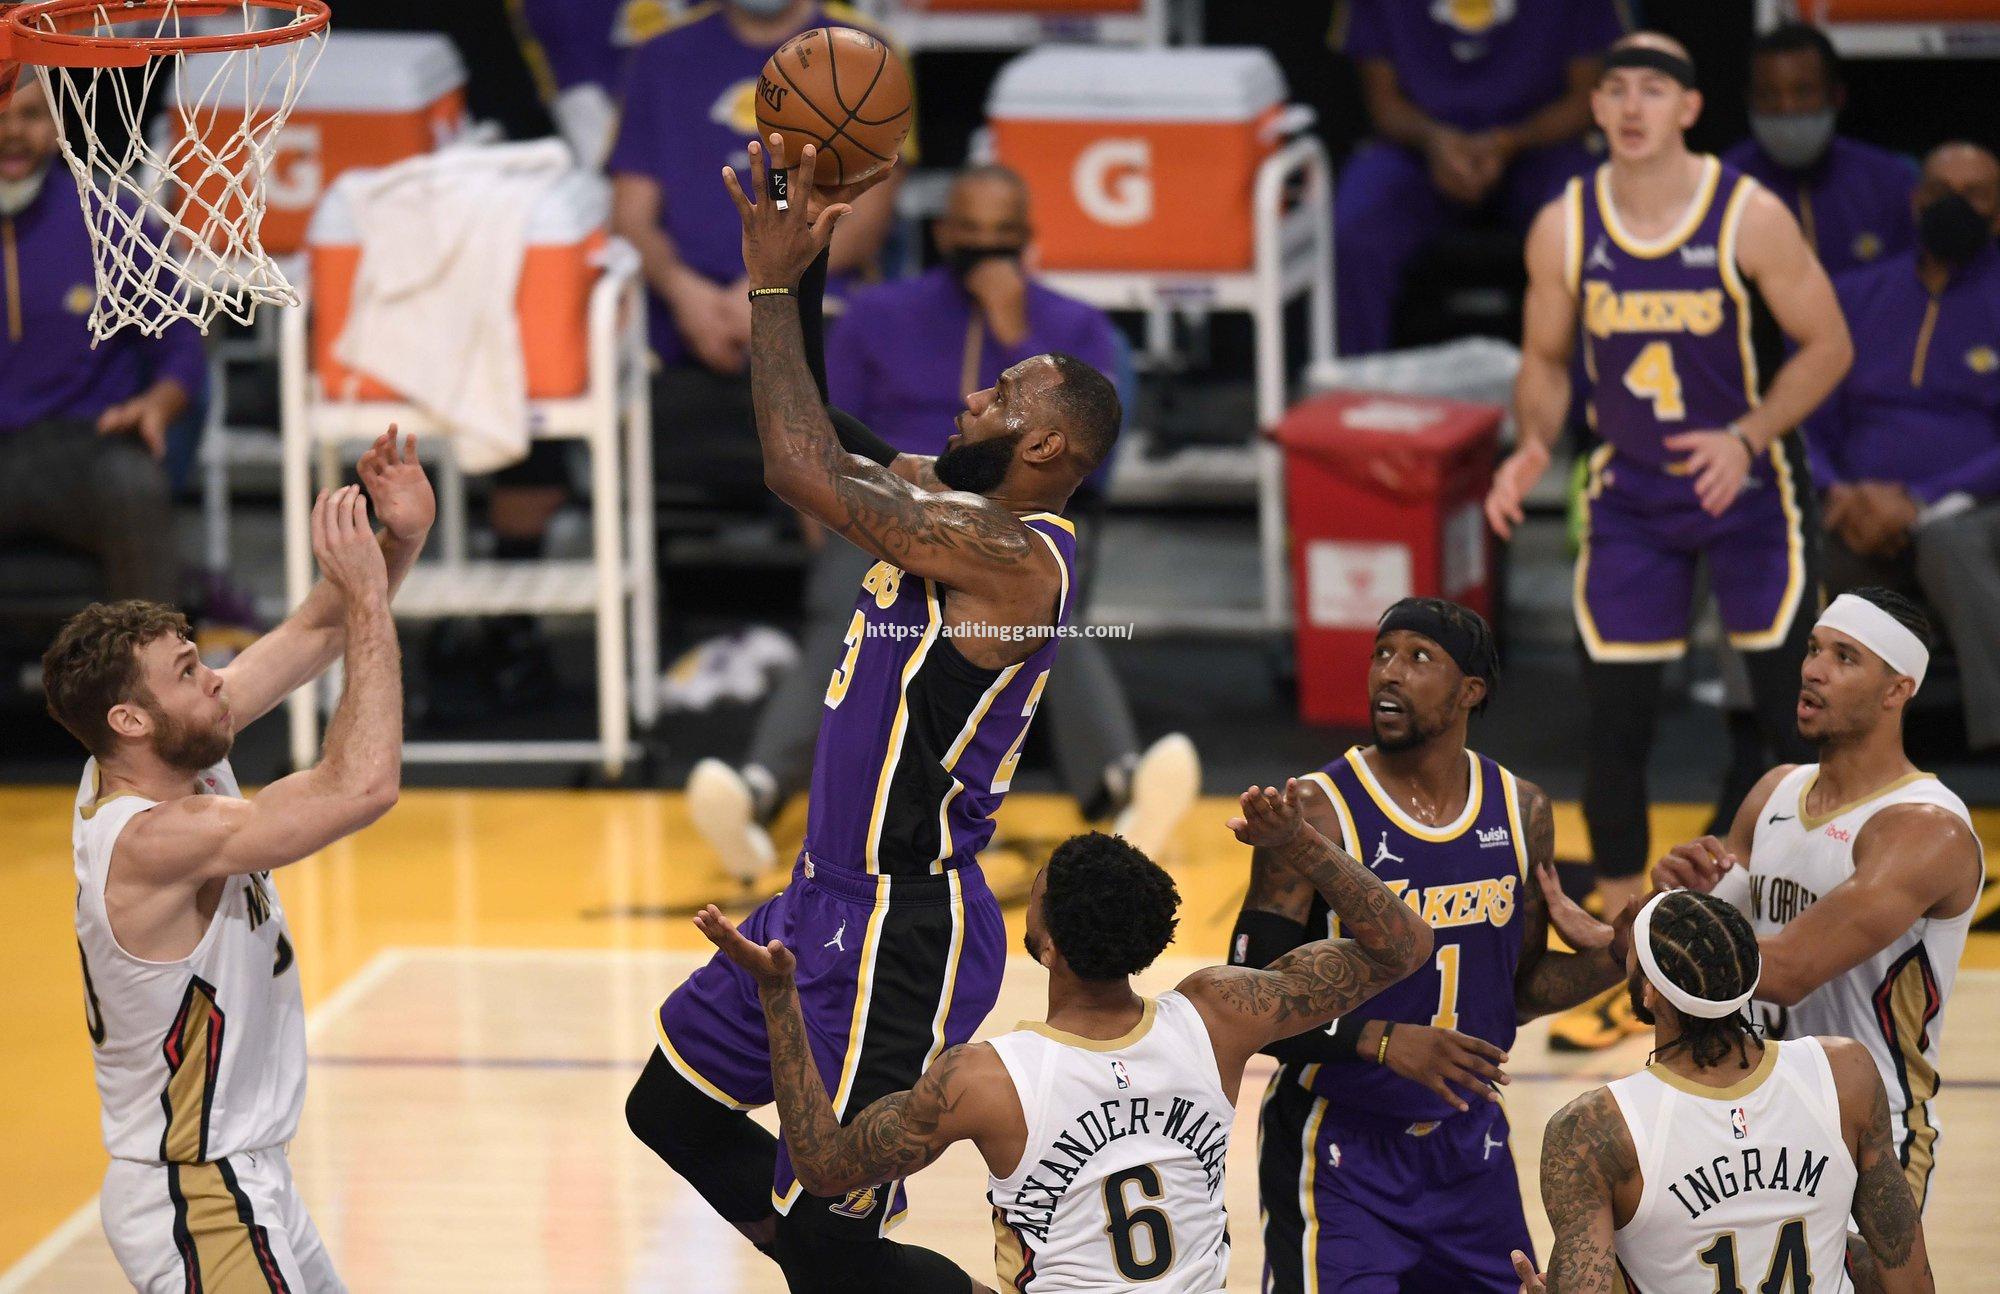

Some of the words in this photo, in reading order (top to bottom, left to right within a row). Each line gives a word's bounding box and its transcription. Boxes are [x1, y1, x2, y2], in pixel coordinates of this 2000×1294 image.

[1072, 138, 1154, 227] G
[1622, 340, 1686, 421] 4
[1475, 826, 1509, 842] wish
[1431, 944, 1460, 1031] 1
[1103, 1162, 1176, 1284] 6
[1668, 1147, 1829, 1219] INGRAM
[1696, 1216, 1815, 1294] 14
